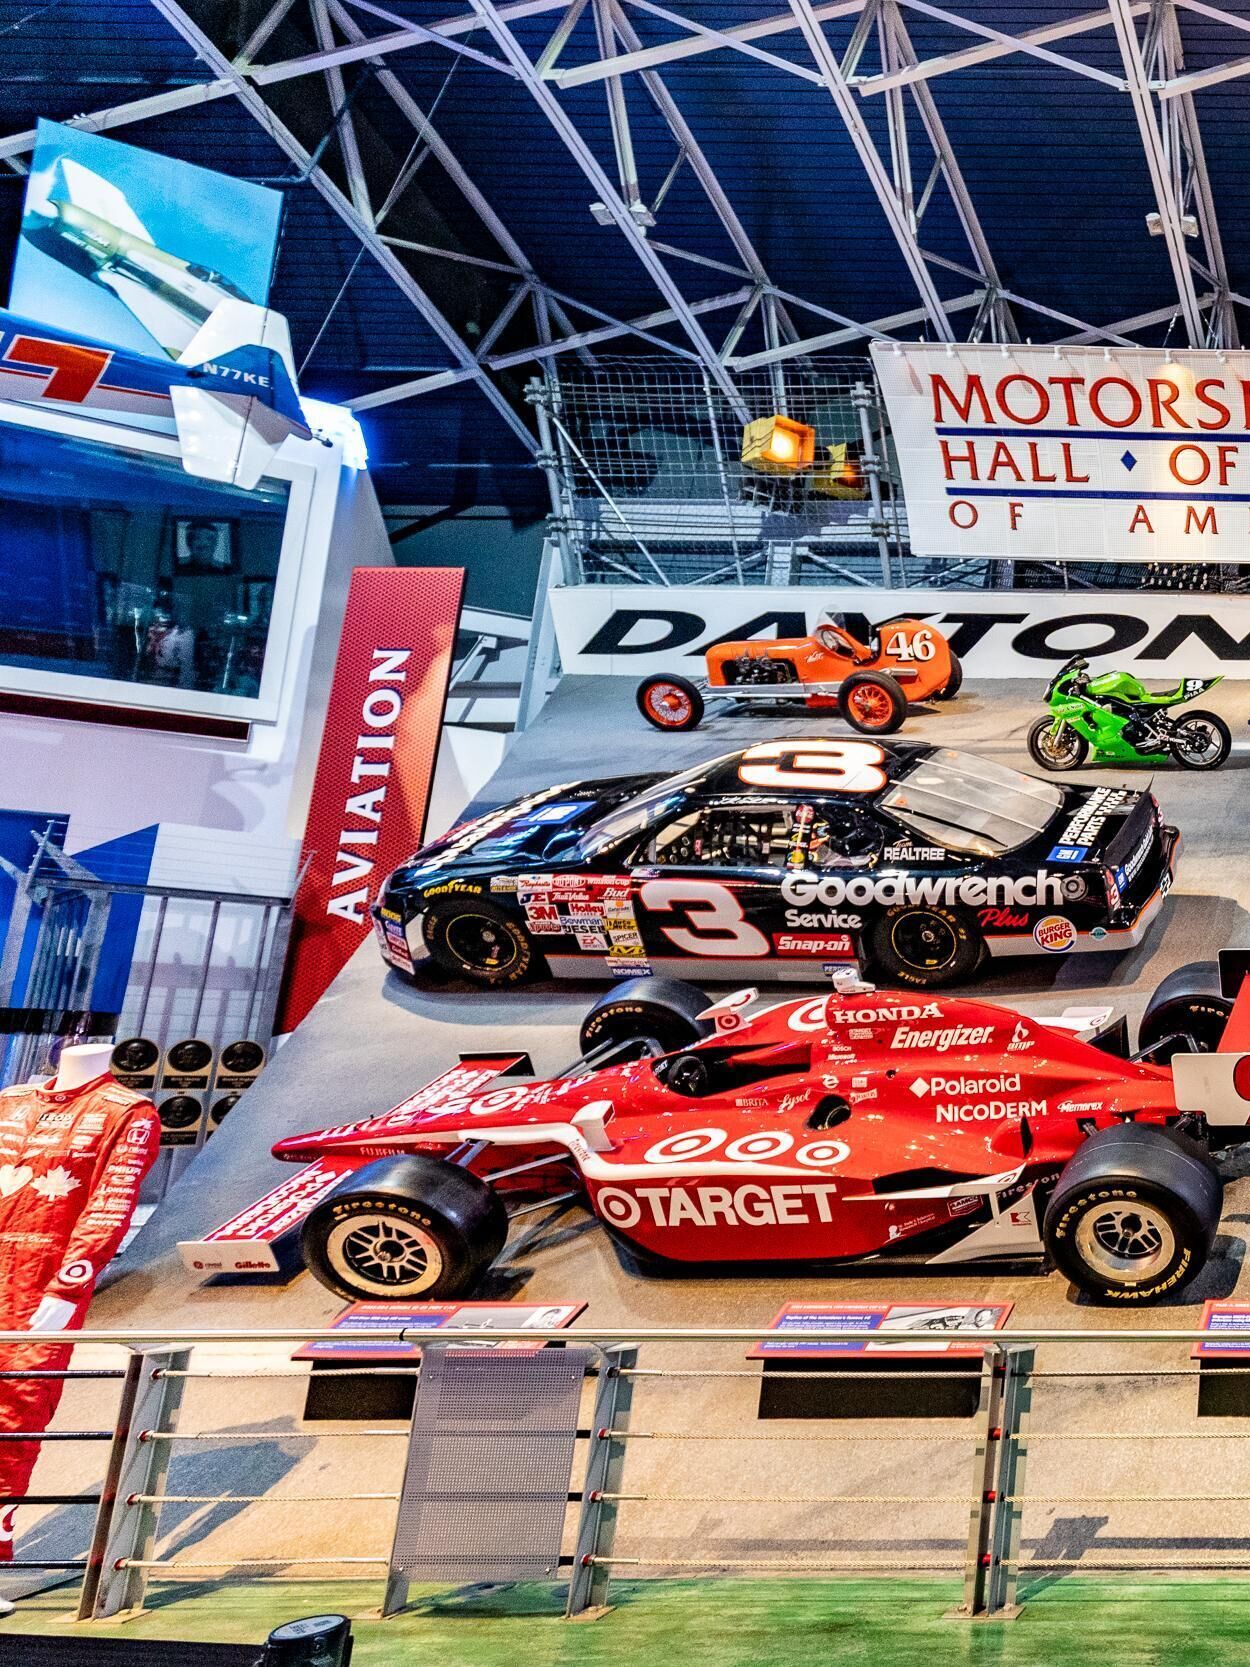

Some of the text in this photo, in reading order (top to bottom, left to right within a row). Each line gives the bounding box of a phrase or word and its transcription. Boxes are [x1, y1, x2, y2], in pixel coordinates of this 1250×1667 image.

[203, 362, 272, 387] N77KE
[942, 440, 1090, 483] HALL
[1169, 444, 1239, 486] OF
[949, 499, 1024, 531] OF
[886, 629, 936, 662] 46
[1184, 687, 1206, 700] PIAA
[1186, 679, 1204, 692] 9
[738, 738, 888, 792] 3
[327, 647, 412, 926] AVIATION
[1058, 787, 1112, 846] PERFORMANCE
[1076, 815, 1107, 847] PARTS
[883, 847, 946, 861] REALTREE
[424, 880, 482, 898] GOODYEAR
[603, 888, 630, 898] Bud
[780, 869, 1063, 907] Goodwrench
[527, 905, 558, 921] 3M
[570, 903, 605, 916] Holley
[640, 878, 771, 957] 3
[784, 909, 862, 929] Service
[977, 906, 1030, 929] Plus
[560, 917, 604, 926] Bowman
[1038, 922, 1071, 938] BURGER
[778, 935, 851, 953] Snap-on
[1040, 930, 1073, 948] KING
[612, 967, 651, 976] NOMEX
[585, 1005, 644, 1039] Firestone
[833, 1003, 944, 1024] HONDA
[890, 1024, 995, 1052] Energizer
[930, 1073, 1021, 1097] Polaroid
[742, 1099, 769, 1107] BRITA
[777, 1088, 811, 1113] Lysol
[1057, 1100, 1104, 1113] Memorex
[331, 1200, 433, 1227] Firestone
[635, 1184, 838, 1227] TARGET
[1055, 1189, 1138, 1239] Firestone
[235, 1261, 270, 1270] Gillette
[1104, 1247, 1192, 1300] FIREHAWK
